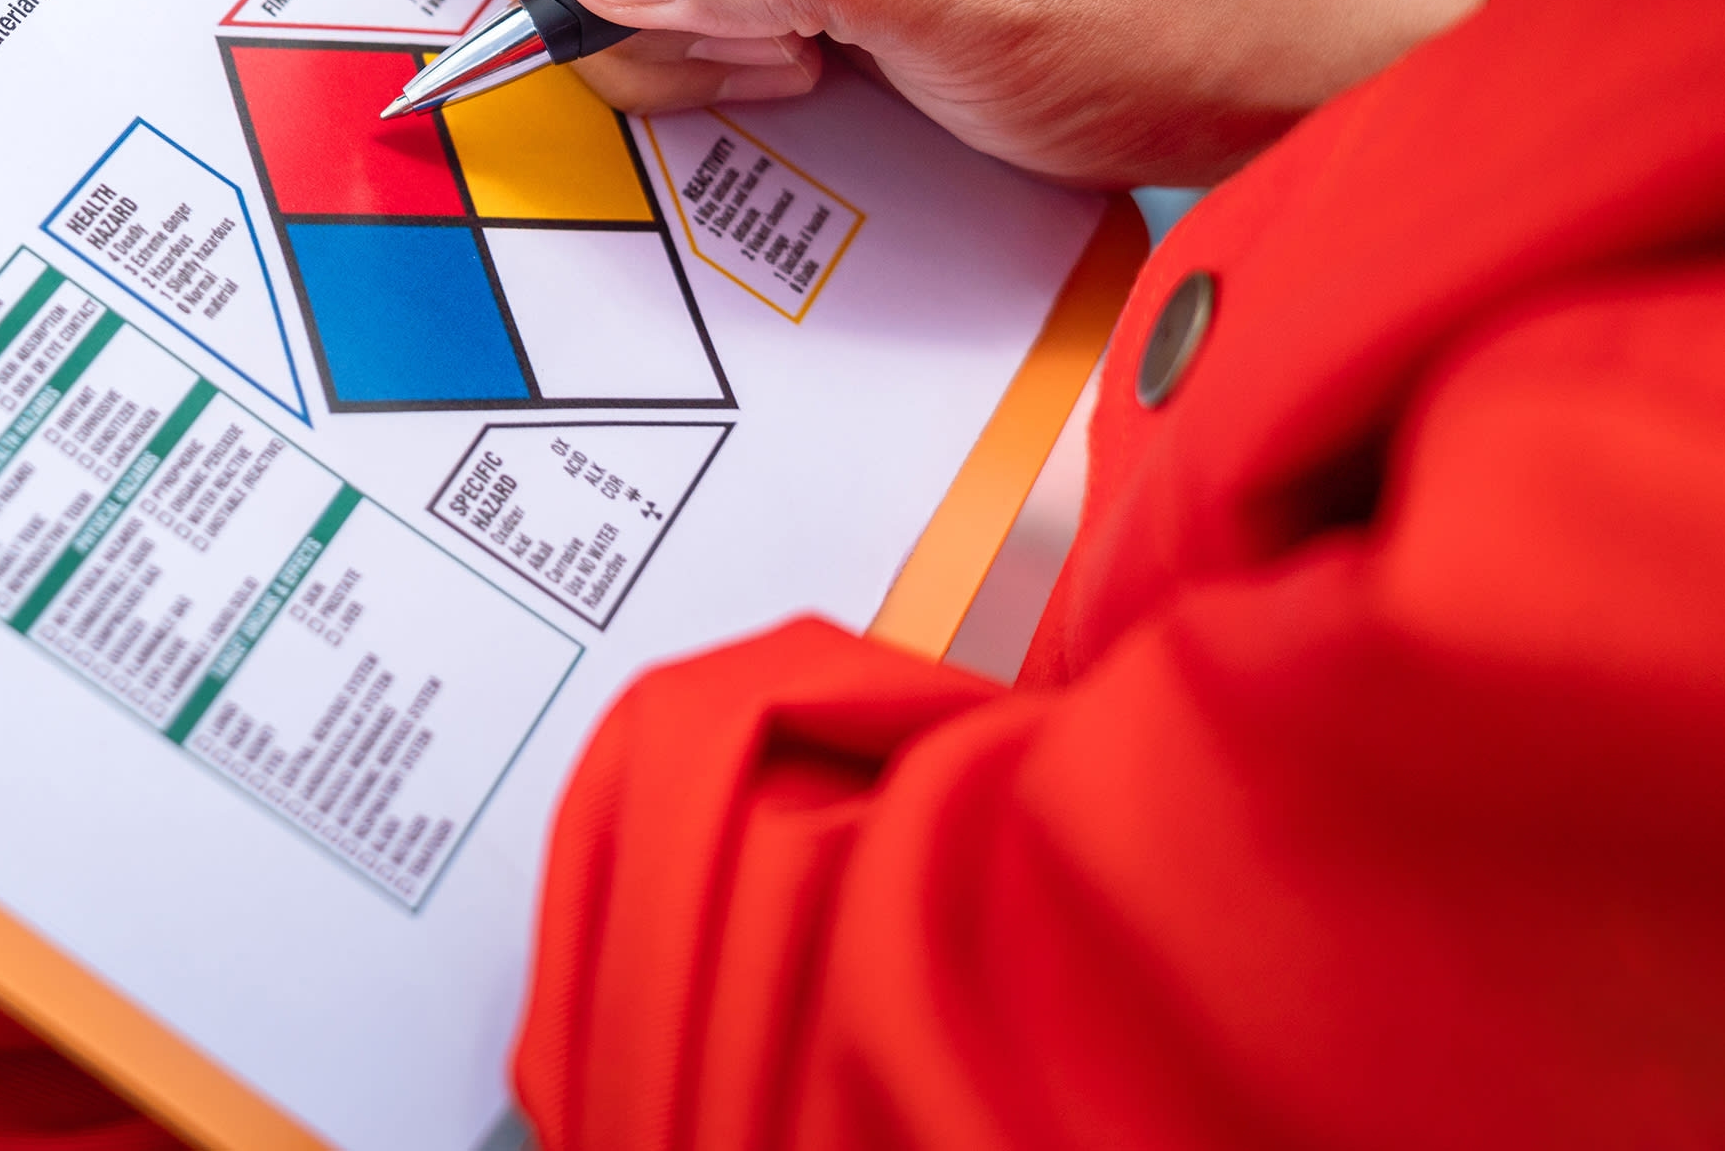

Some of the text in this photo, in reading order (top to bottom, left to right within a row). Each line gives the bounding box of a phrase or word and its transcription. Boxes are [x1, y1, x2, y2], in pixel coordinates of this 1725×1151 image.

[683, 135, 737, 203] REACTIVITY
[66, 183, 118, 236] HEALTH
[86, 196, 138, 251] HAZARD
[107, 223, 149, 263] 4 Deadly
[123, 202, 192, 276] 3 Extreme danger
[140, 233, 194, 290] 2 Hazardous
[159, 217, 236, 301] 1 Slightly hazardous
[182, 269, 218, 306] Normal
[203, 277, 239, 320] material
[15, 304, 68, 363] ABSORPTION
[42, 339, 66, 362] EYE
[58, 295, 99, 343] CONTACT
[15, 388, 60, 435] HAZARDS
[55, 385, 97, 431] IRRITANT
[72, 388, 123, 444] CORROSIVE
[90, 400, 140, 457] SENSITIZER
[106, 408, 161, 469] CARCINOGEN
[550, 437, 571, 457] OX
[562, 450, 588, 479] ACID
[151, 438, 205, 501] PYROPHORIC
[169, 423, 244, 514] ORGANIC PEROXIDE
[186, 445, 253, 526] WATER REACTIVE
[204, 486, 248, 538] UNSTABLE
[241, 437, 287, 490] (REACTIVE)
[448, 451, 503, 517] SPECIFIC
[583, 462, 607, 488] ALK
[600, 474, 625, 500] COR
[72, 500, 122, 550] PHYSICAL
[115, 453, 159, 501] HAZARDS
[469, 474, 518, 532] HAZARD
[489, 505, 524, 546] Oxidizer
[276, 537, 322, 585] EFFECTS
[508, 533, 533, 559] Acid
[527, 540, 555, 572] Alkali
[544, 537, 585, 585] Corrosive
[563, 522, 619, 598] Use NO WATER
[317, 567, 362, 620] PROSTATE
[581, 553, 628, 610] Radioactive
